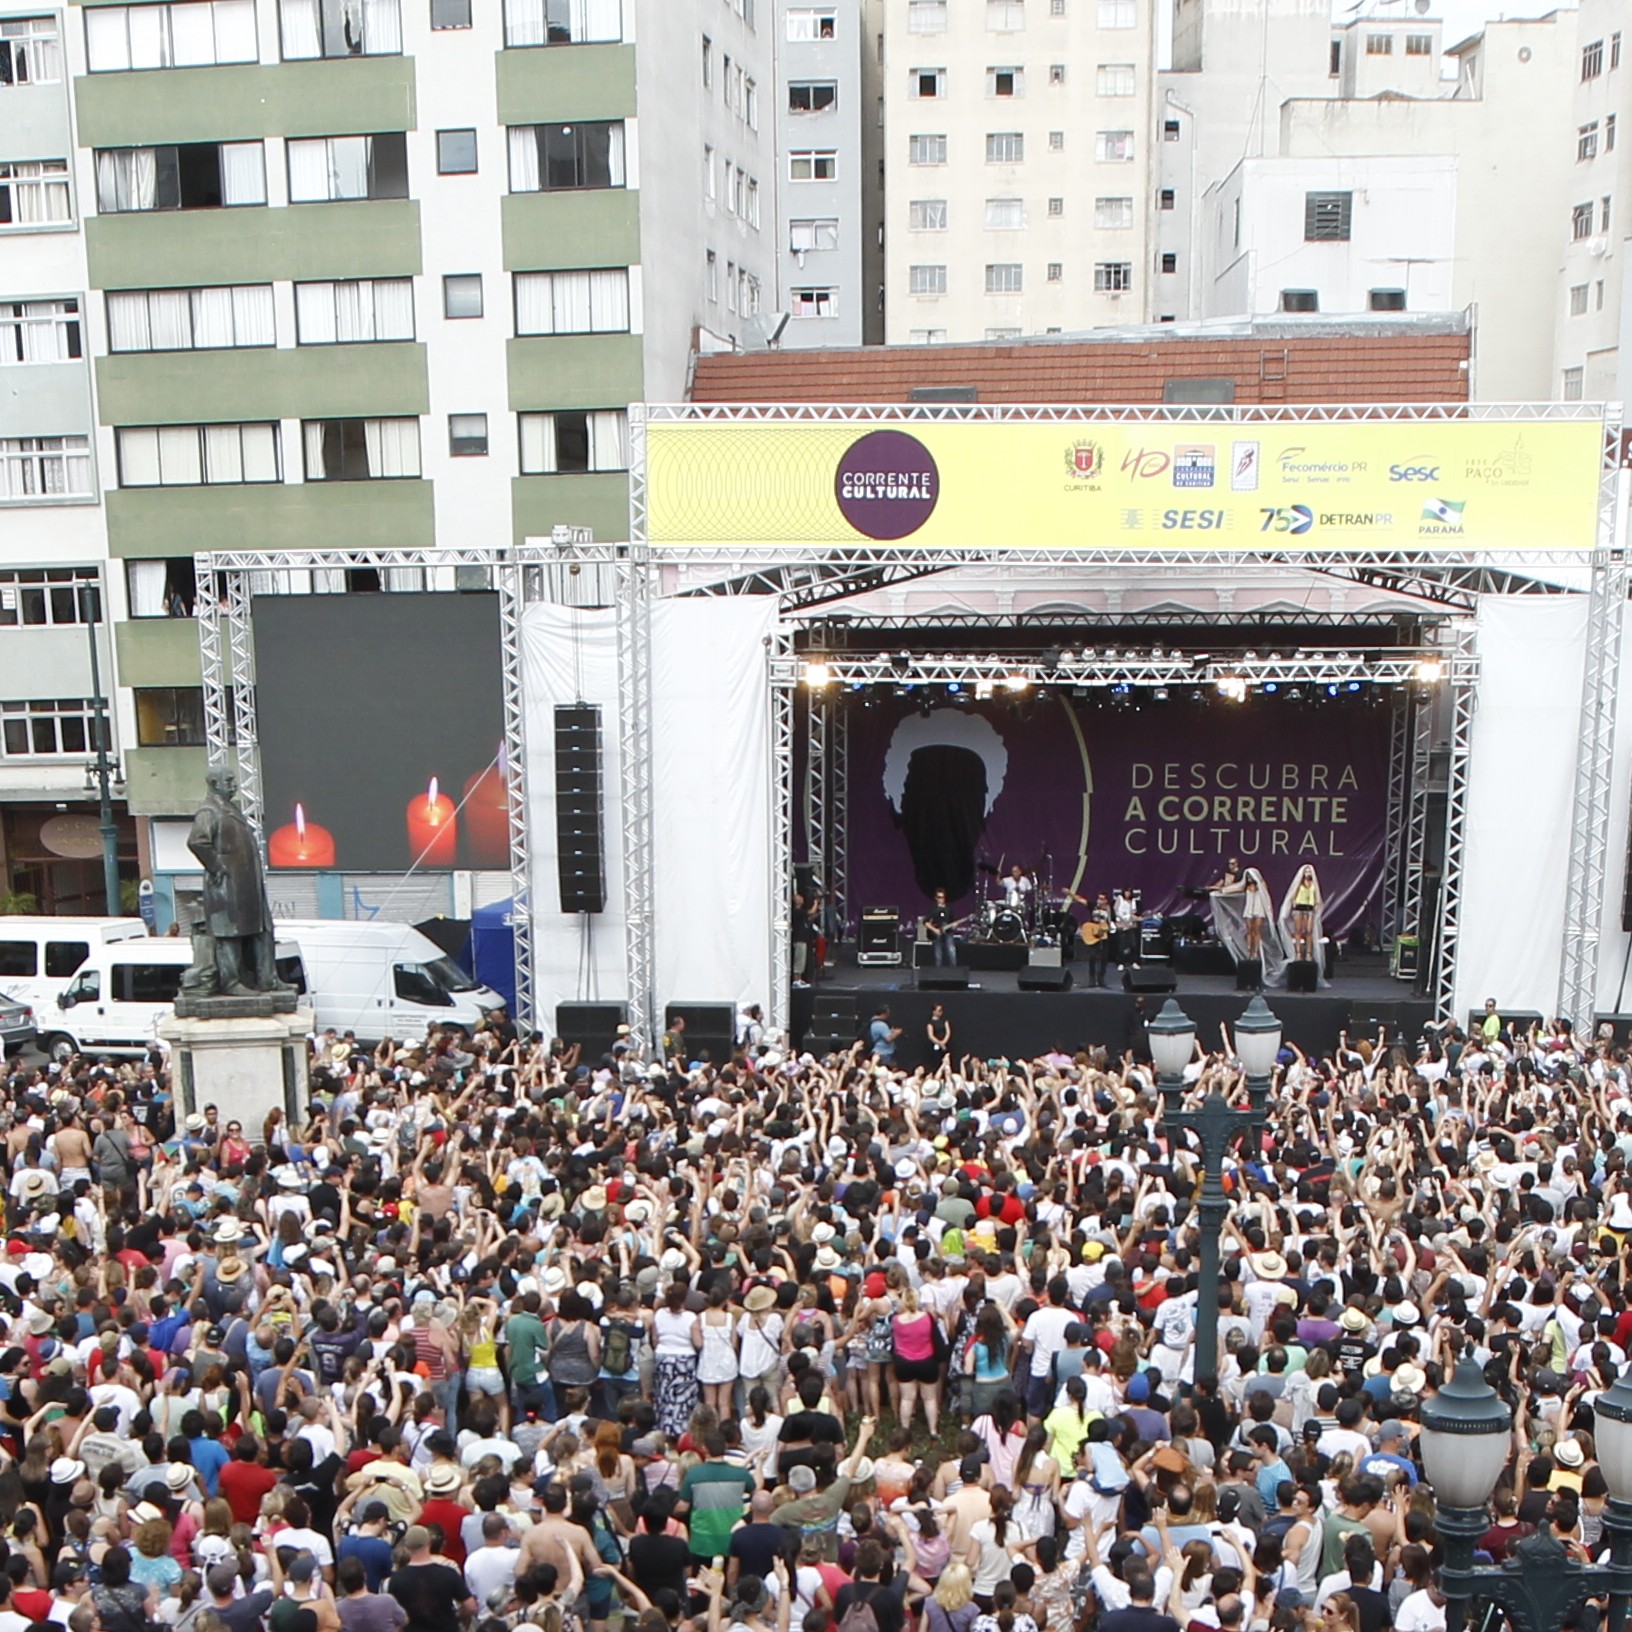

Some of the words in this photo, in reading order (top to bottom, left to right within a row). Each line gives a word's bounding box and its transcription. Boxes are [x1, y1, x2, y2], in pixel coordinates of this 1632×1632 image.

[1282, 461, 1349, 472] Fecomércio
[1352, 461, 1368, 472] PR
[1388, 464, 1441, 482] Sesc
[1464, 466, 1503, 484] PAÇO
[842, 472, 931, 486] CORRENTE
[1063, 484, 1102, 492] CURITIBA
[842, 486, 931, 499] CULTURAL
[1161, 509, 1225, 530] SESI
[1131, 763, 1360, 791] DESCUBRA
[1124, 796, 1147, 822] A
[1157, 796, 1349, 823] CORRENTE
[1124, 828, 1345, 857] CULTURAL
